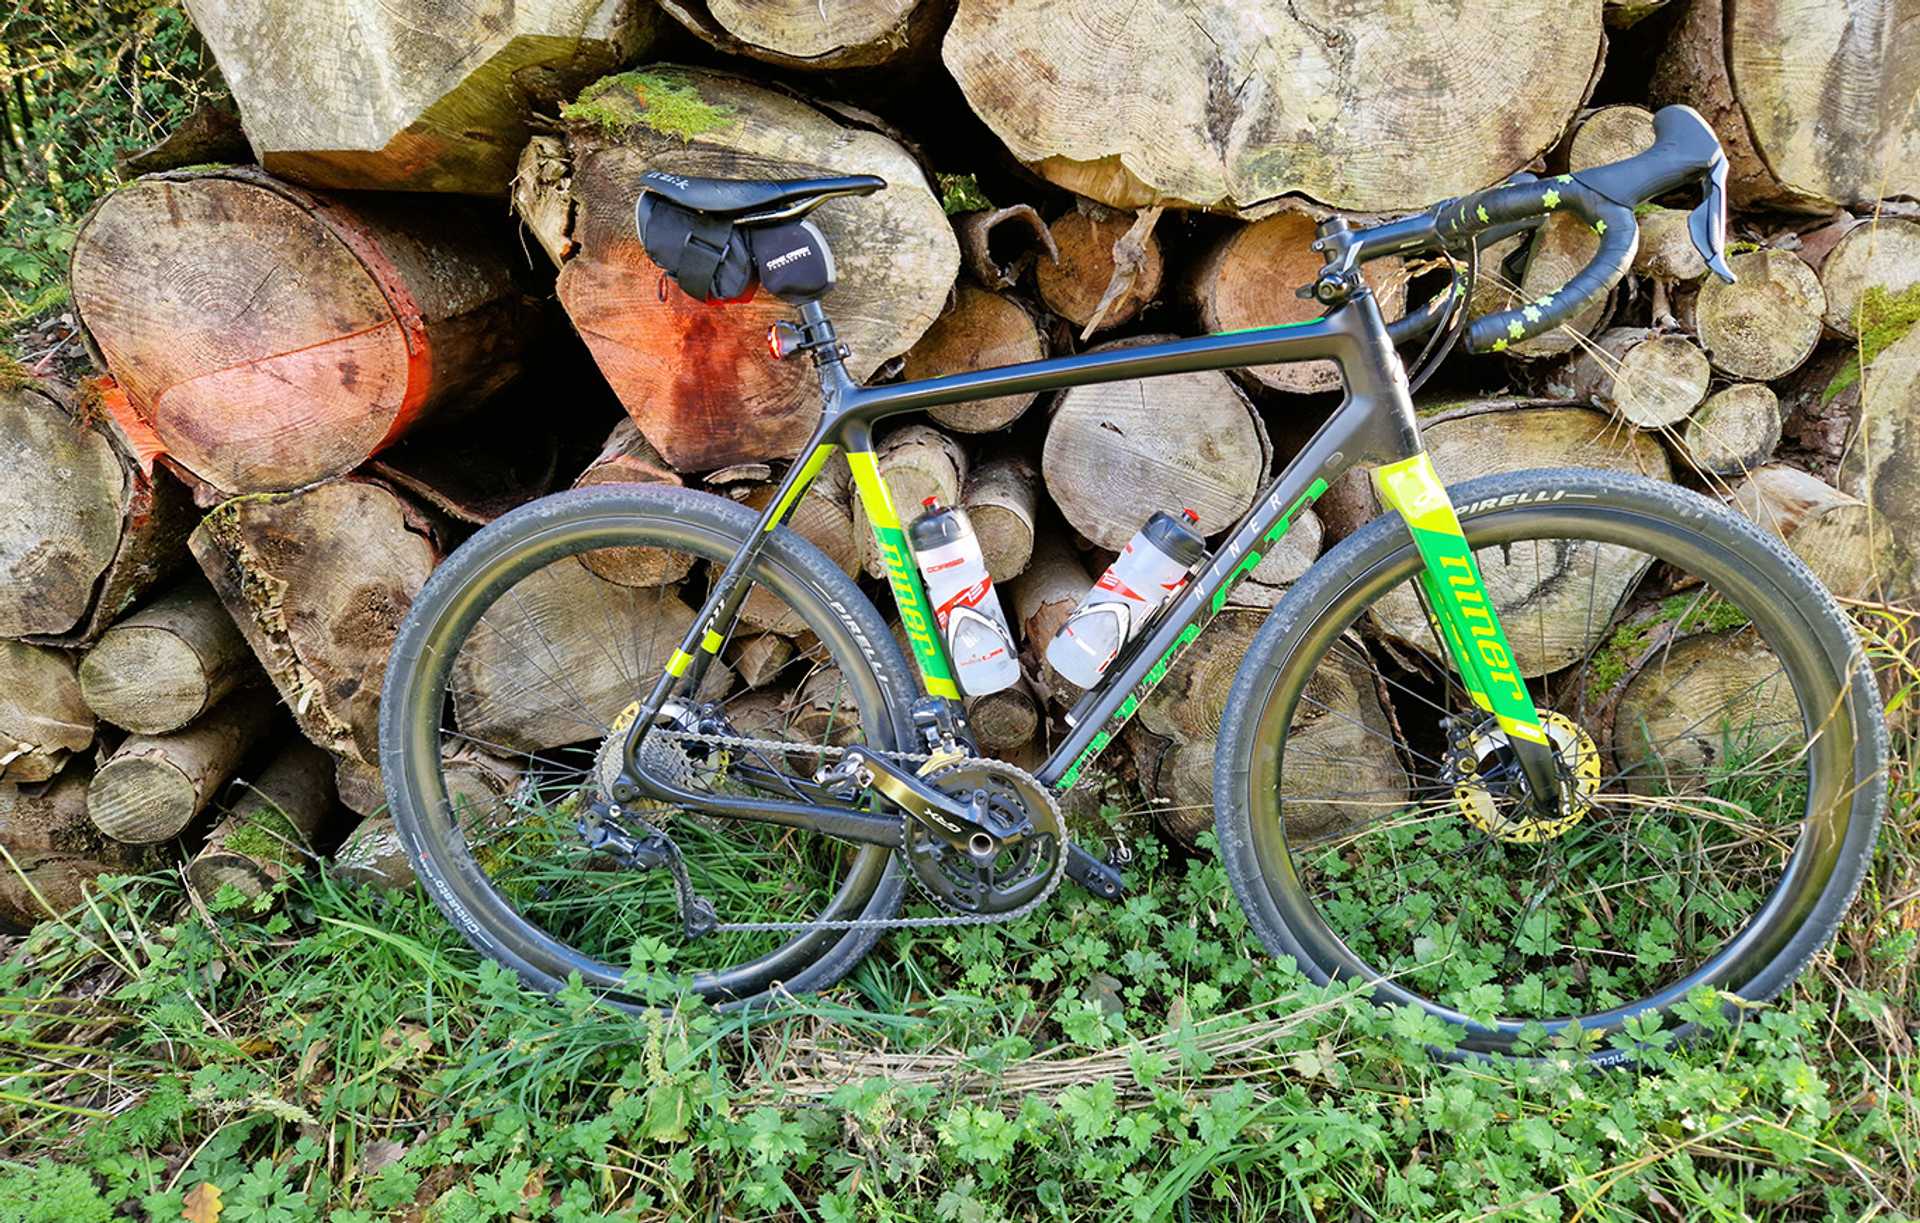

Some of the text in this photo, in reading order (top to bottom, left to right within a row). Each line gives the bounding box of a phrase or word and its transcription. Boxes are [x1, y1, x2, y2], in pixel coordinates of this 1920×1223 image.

[1194, 495, 1283, 601] NINER
[1455, 489, 1567, 516] PIRELLI
[830, 601, 889, 683] PIRELLI
[880, 543, 937, 658] niner
[1439, 553, 1525, 701] niner
[435, 879, 480, 935] Cinturato
